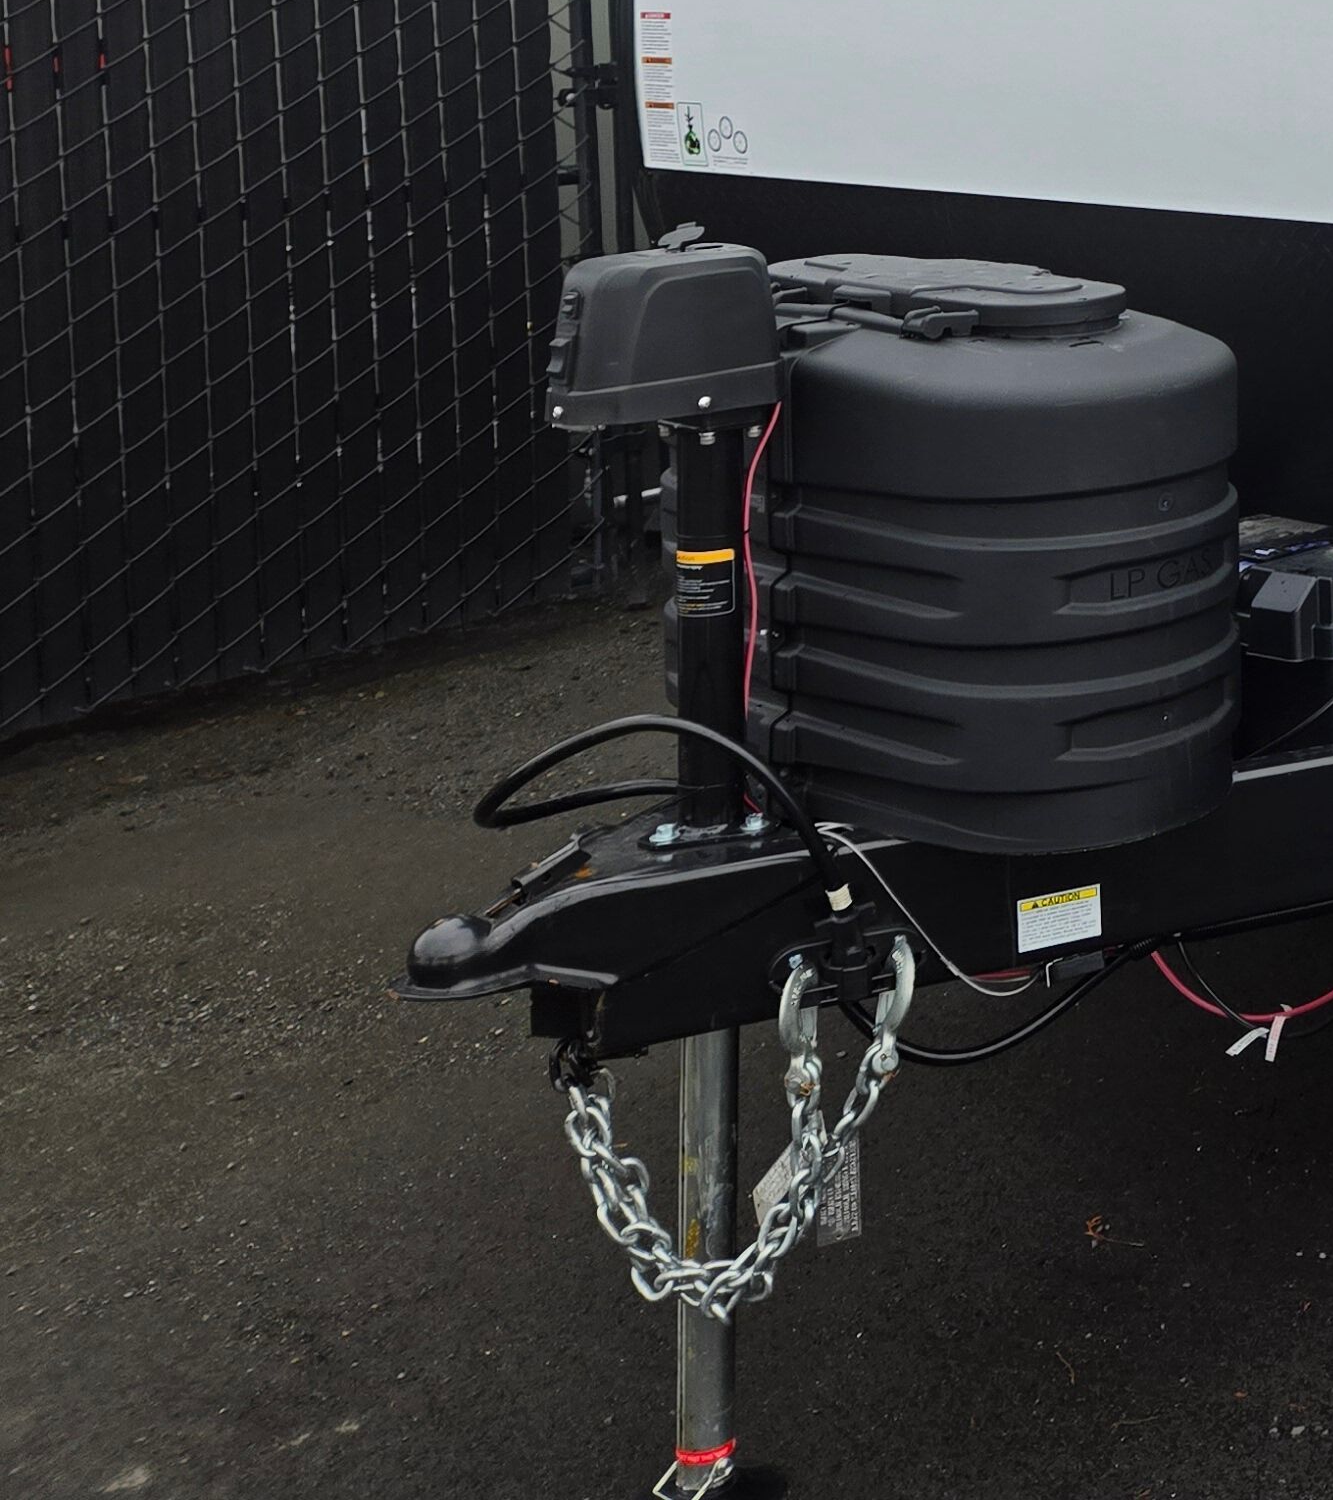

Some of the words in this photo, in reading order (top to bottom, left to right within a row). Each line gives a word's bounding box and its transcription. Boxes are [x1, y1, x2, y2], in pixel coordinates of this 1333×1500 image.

[1110, 568, 1145, 601] LP
[1157, 547, 1213, 588] GAS
[1041, 891, 1080, 906] CAUTION
